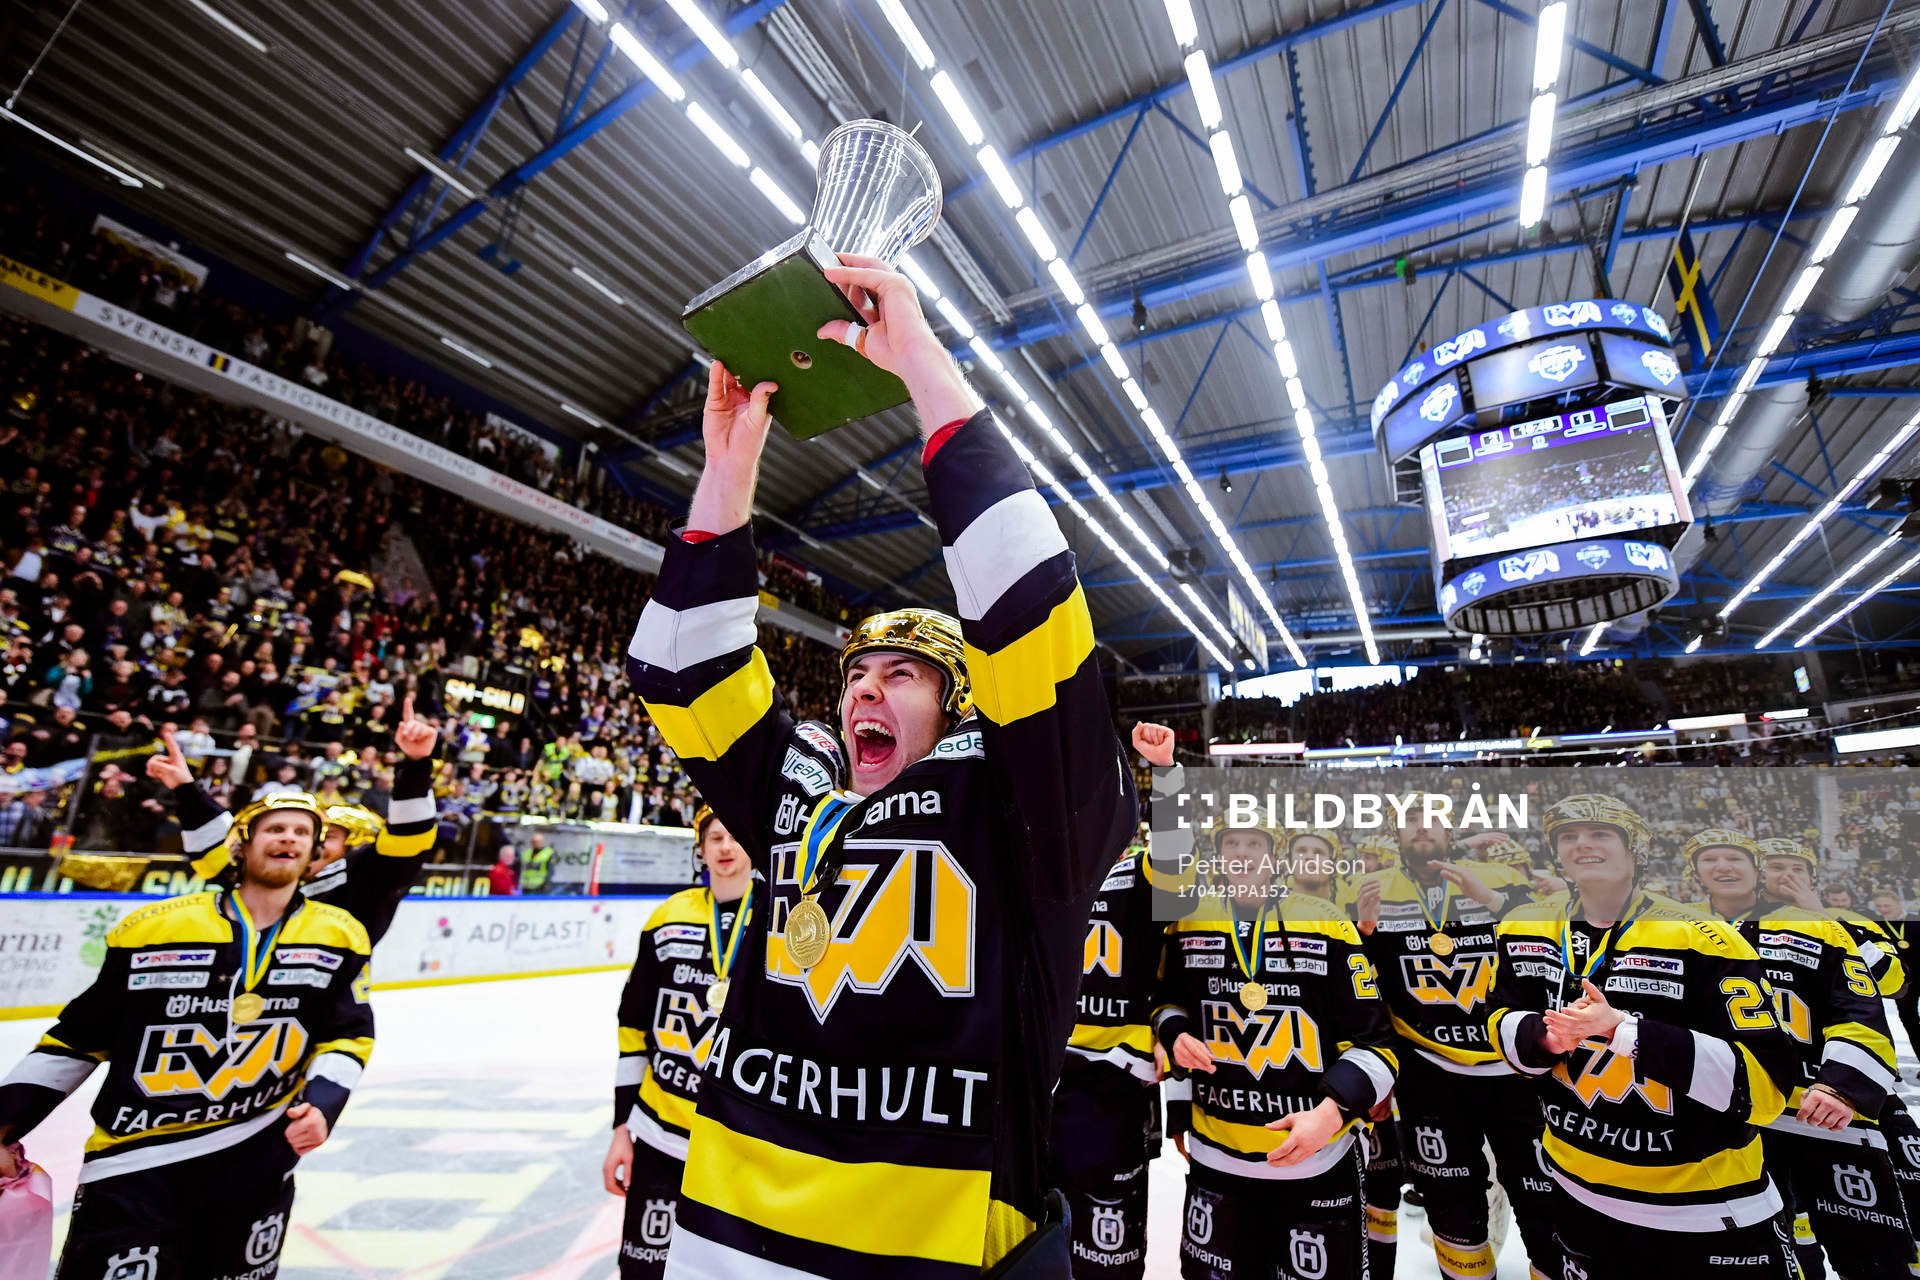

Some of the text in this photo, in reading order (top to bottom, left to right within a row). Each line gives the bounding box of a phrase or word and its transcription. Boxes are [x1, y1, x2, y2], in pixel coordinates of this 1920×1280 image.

[98, 306, 201, 359] SVENSK
[515, 919, 587, 941] PLAST
[1650, 908, 1728, 946] FAGERHULT
[1278, 940, 1324, 951] INERSPORT
[1773, 934, 1820, 951] INTERSPORT
[1221, 978, 1300, 997] Husarna
[1619, 977, 1681, 995] Liljedahl
[704, 1028, 988, 1127] AGERHULT
[1409, 1159, 1470, 1179] Husqvarna
[1816, 1197, 1904, 1230] Husqvarna
[1073, 1240, 1140, 1267] Husqvarna
